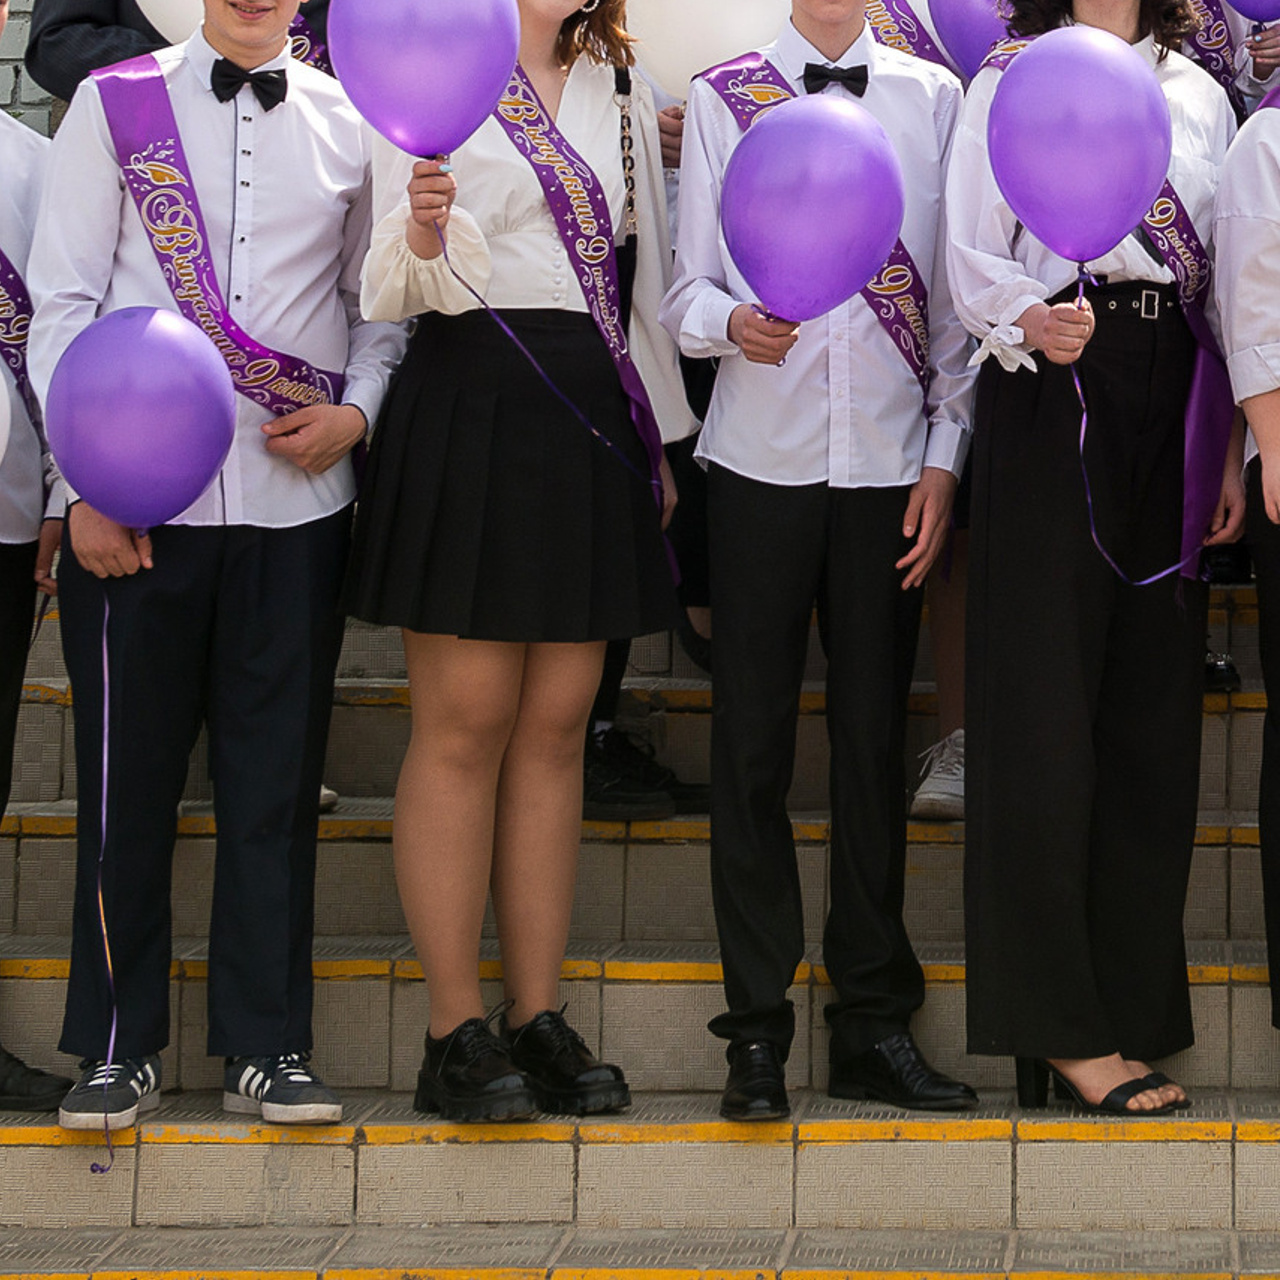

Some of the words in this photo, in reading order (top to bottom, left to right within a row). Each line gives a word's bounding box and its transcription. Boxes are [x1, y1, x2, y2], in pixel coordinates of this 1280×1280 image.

[1195, 20, 1228, 50] 9
[1143, 196, 1177, 228] 9
[575, 235, 610, 265] 9
[140, 187, 248, 367] Выпускник
[231, 357, 281, 387] 9
[865, 264, 914, 295] 9
